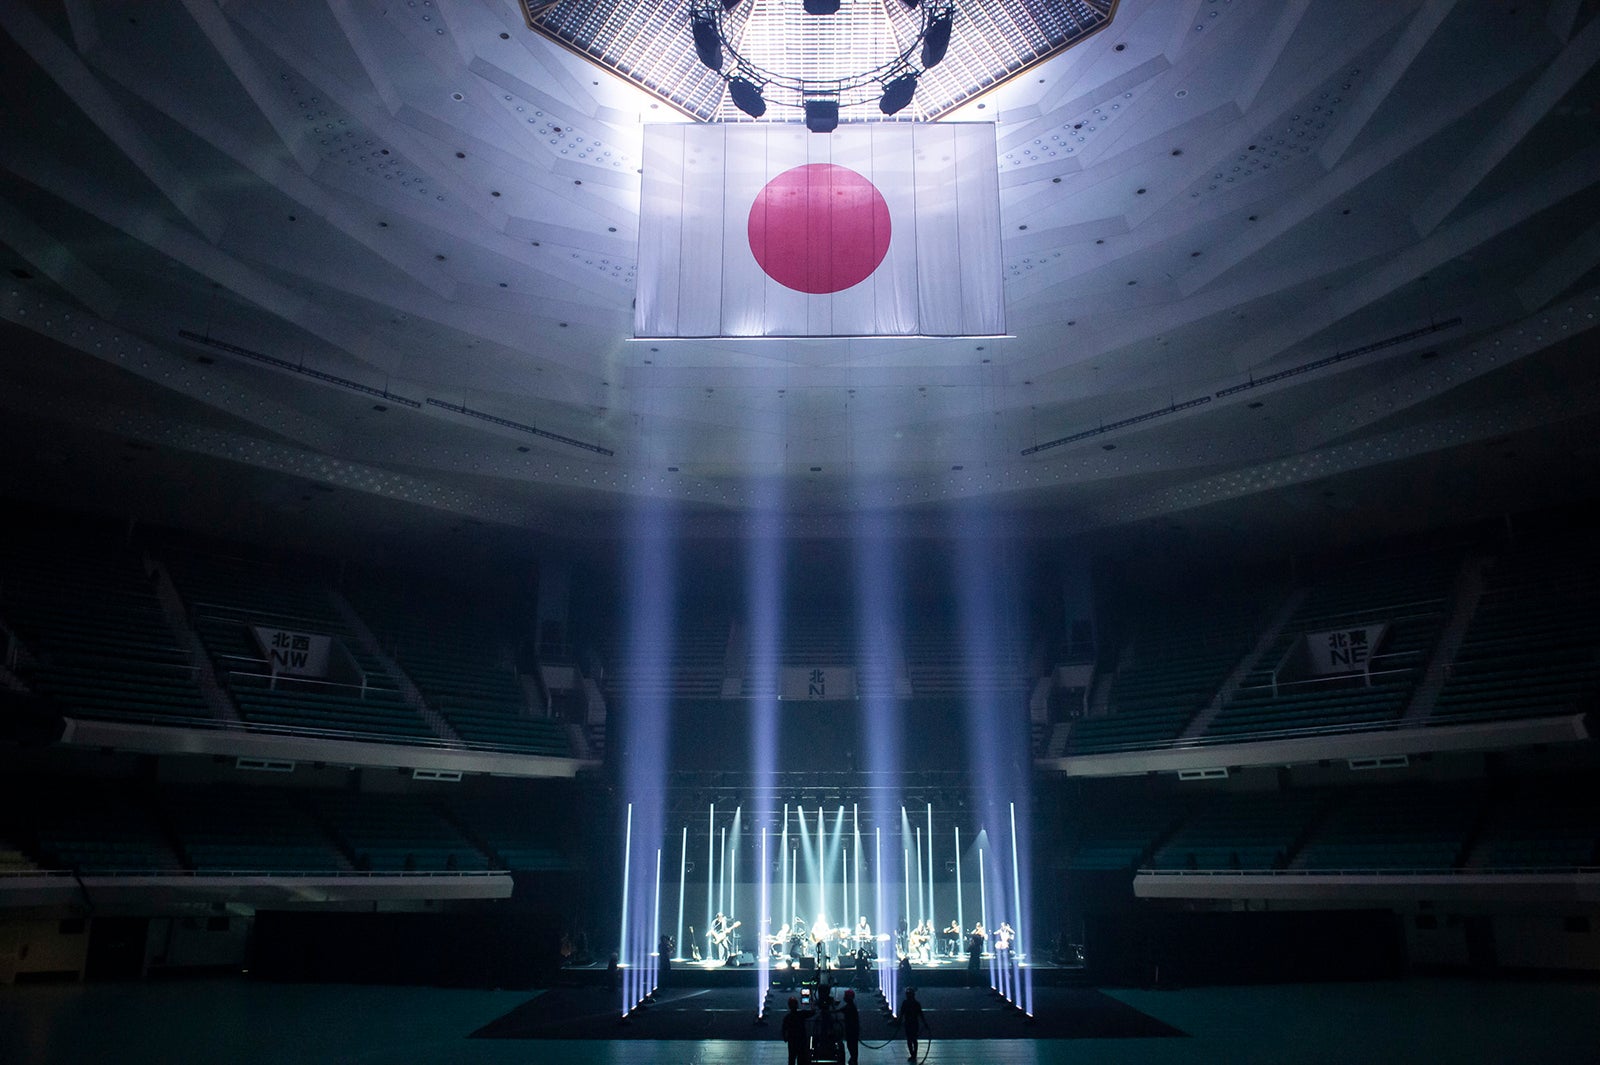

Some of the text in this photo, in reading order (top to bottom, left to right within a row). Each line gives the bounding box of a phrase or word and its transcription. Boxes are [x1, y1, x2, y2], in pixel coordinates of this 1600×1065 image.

[271, 632, 310, 650] 北西
[1329, 630, 1368, 648] 北東
[271, 649, 308, 667] NW
[1331, 646, 1367, 665] NE
[809, 669, 825, 683] 北
[809, 684, 825, 698] N
